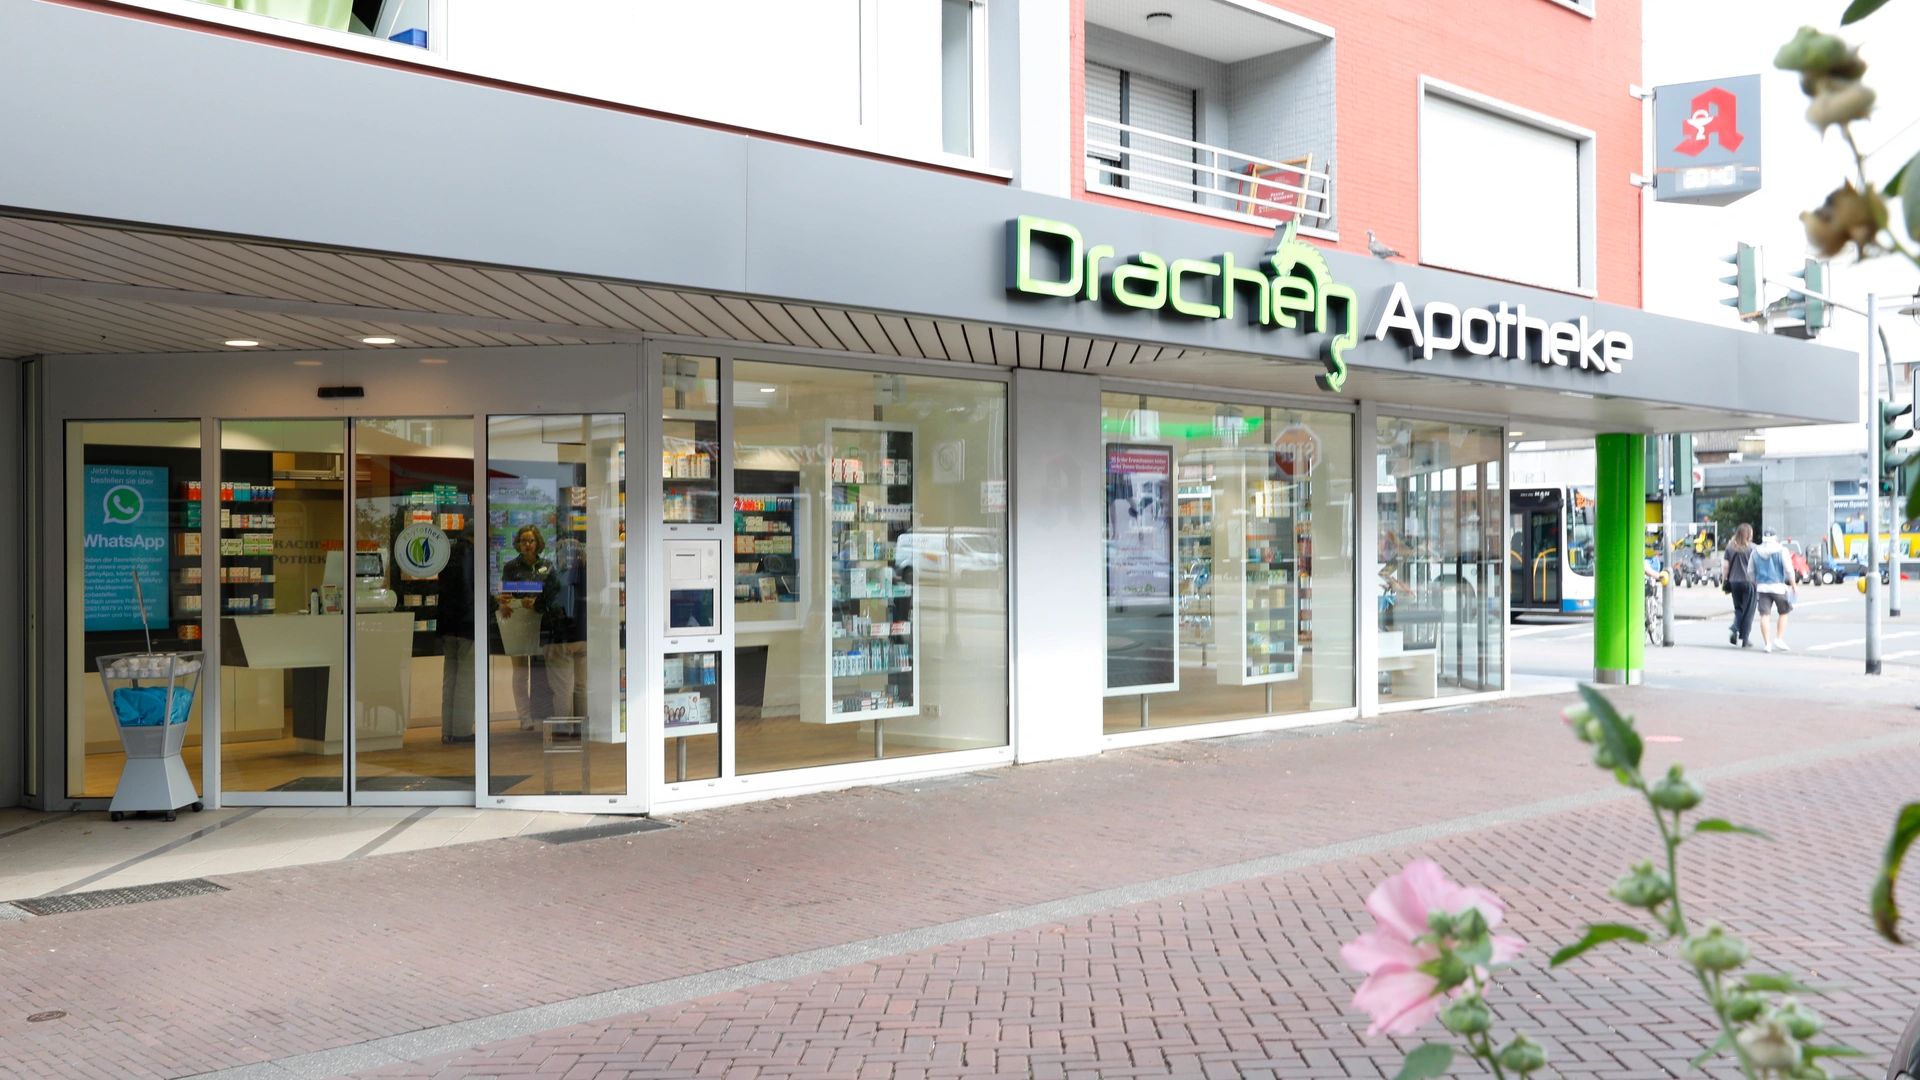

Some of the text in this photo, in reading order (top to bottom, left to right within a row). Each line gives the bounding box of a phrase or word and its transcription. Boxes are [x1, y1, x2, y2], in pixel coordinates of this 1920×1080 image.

[1010, 214, 1634, 374] Drachen Apotheke
[84, 534, 165, 549] WhatsApp
